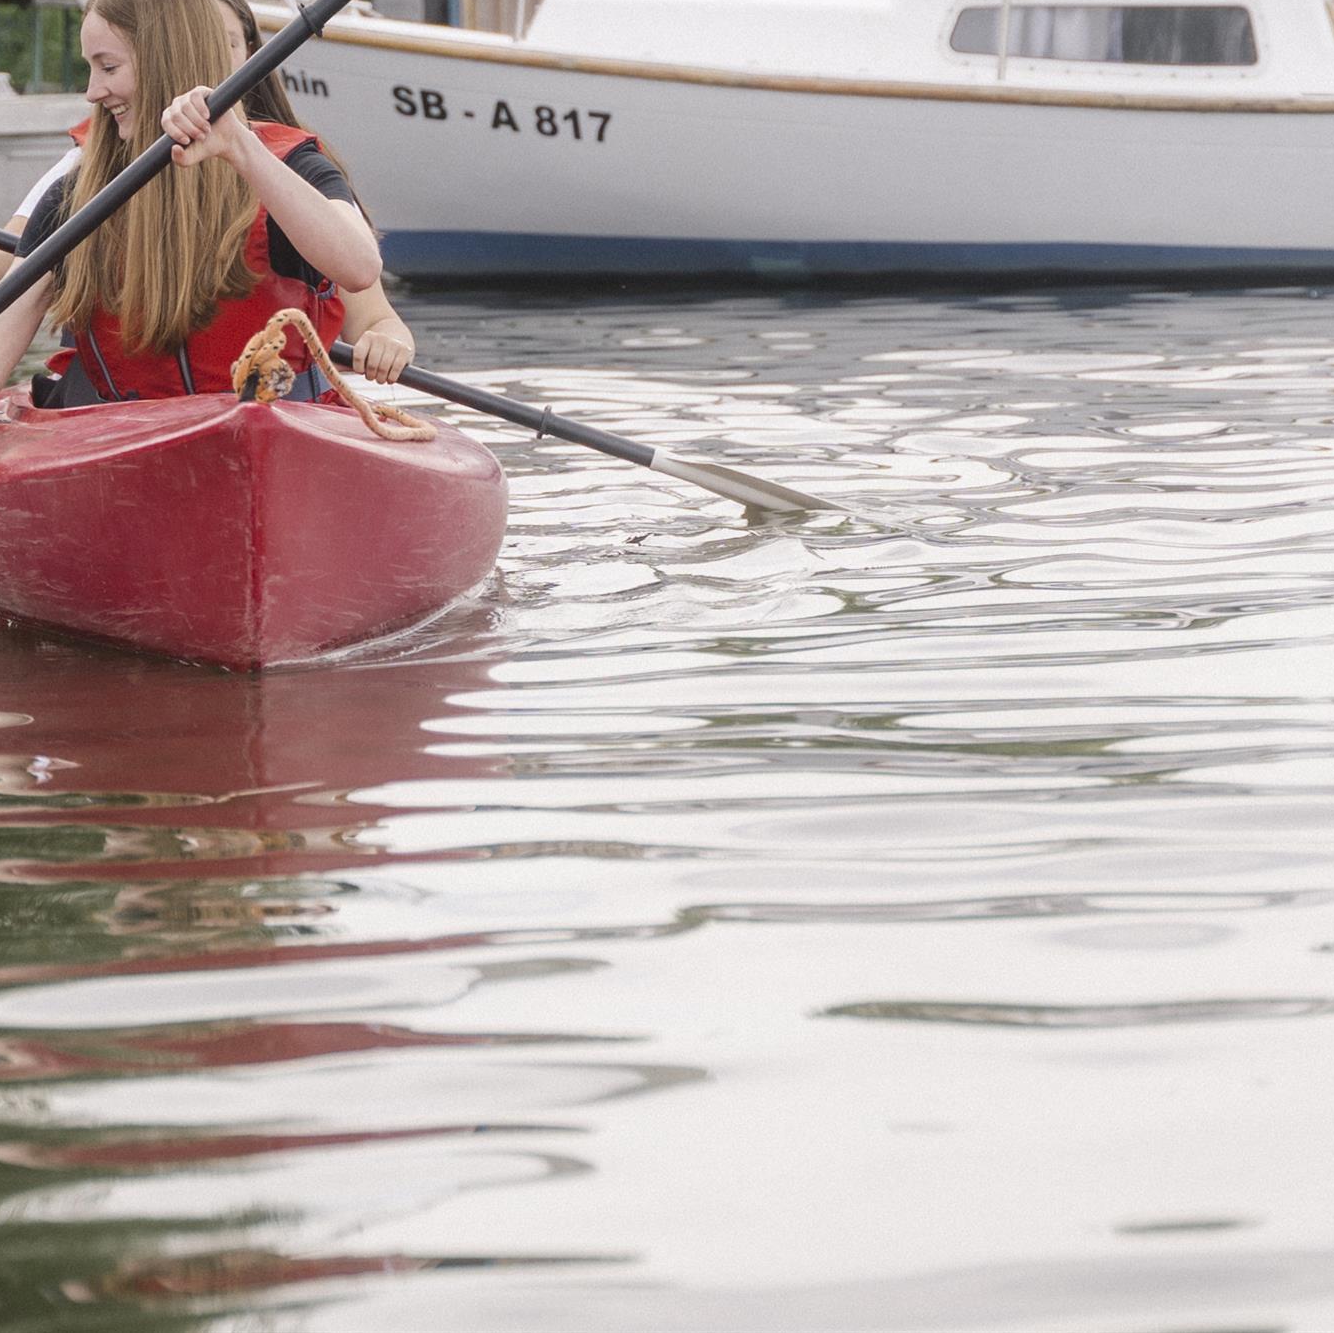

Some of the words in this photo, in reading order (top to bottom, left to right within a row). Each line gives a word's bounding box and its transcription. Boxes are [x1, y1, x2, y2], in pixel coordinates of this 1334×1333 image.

[280, 68, 330, 98] hin
[392, 85, 448, 121] SB
[490, 100, 519, 133] A
[534, 104, 612, 143] 817
